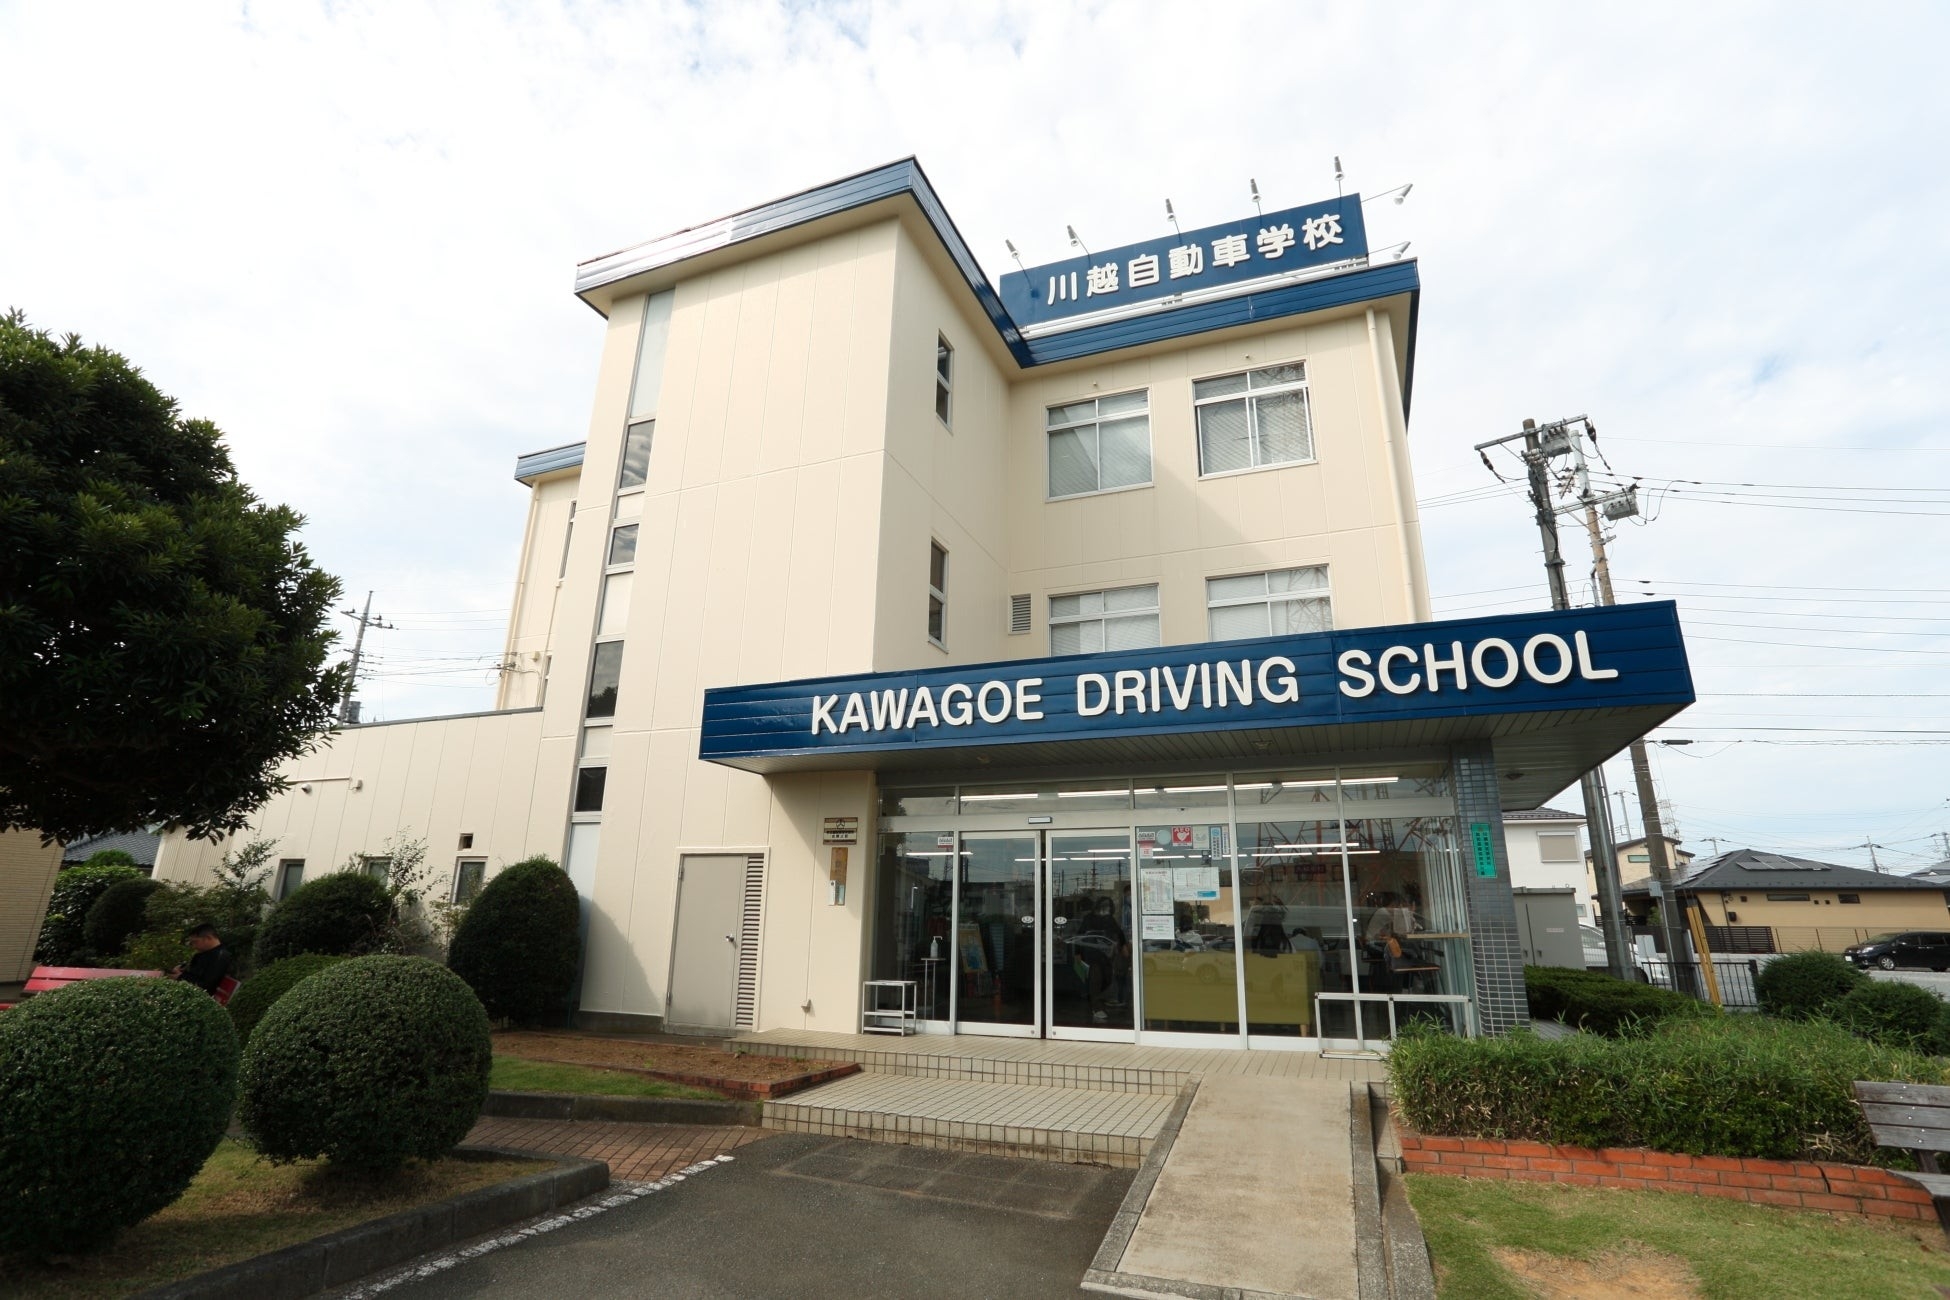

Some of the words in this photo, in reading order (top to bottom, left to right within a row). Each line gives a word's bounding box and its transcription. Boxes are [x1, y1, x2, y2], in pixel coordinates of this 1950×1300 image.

[1047, 213, 1344, 305] 川越自動車学校
[810, 676, 1044, 736] KAWAGOE
[1075, 655, 1300, 719] DRIVING
[1336, 629, 1620, 699] SCHOOL
